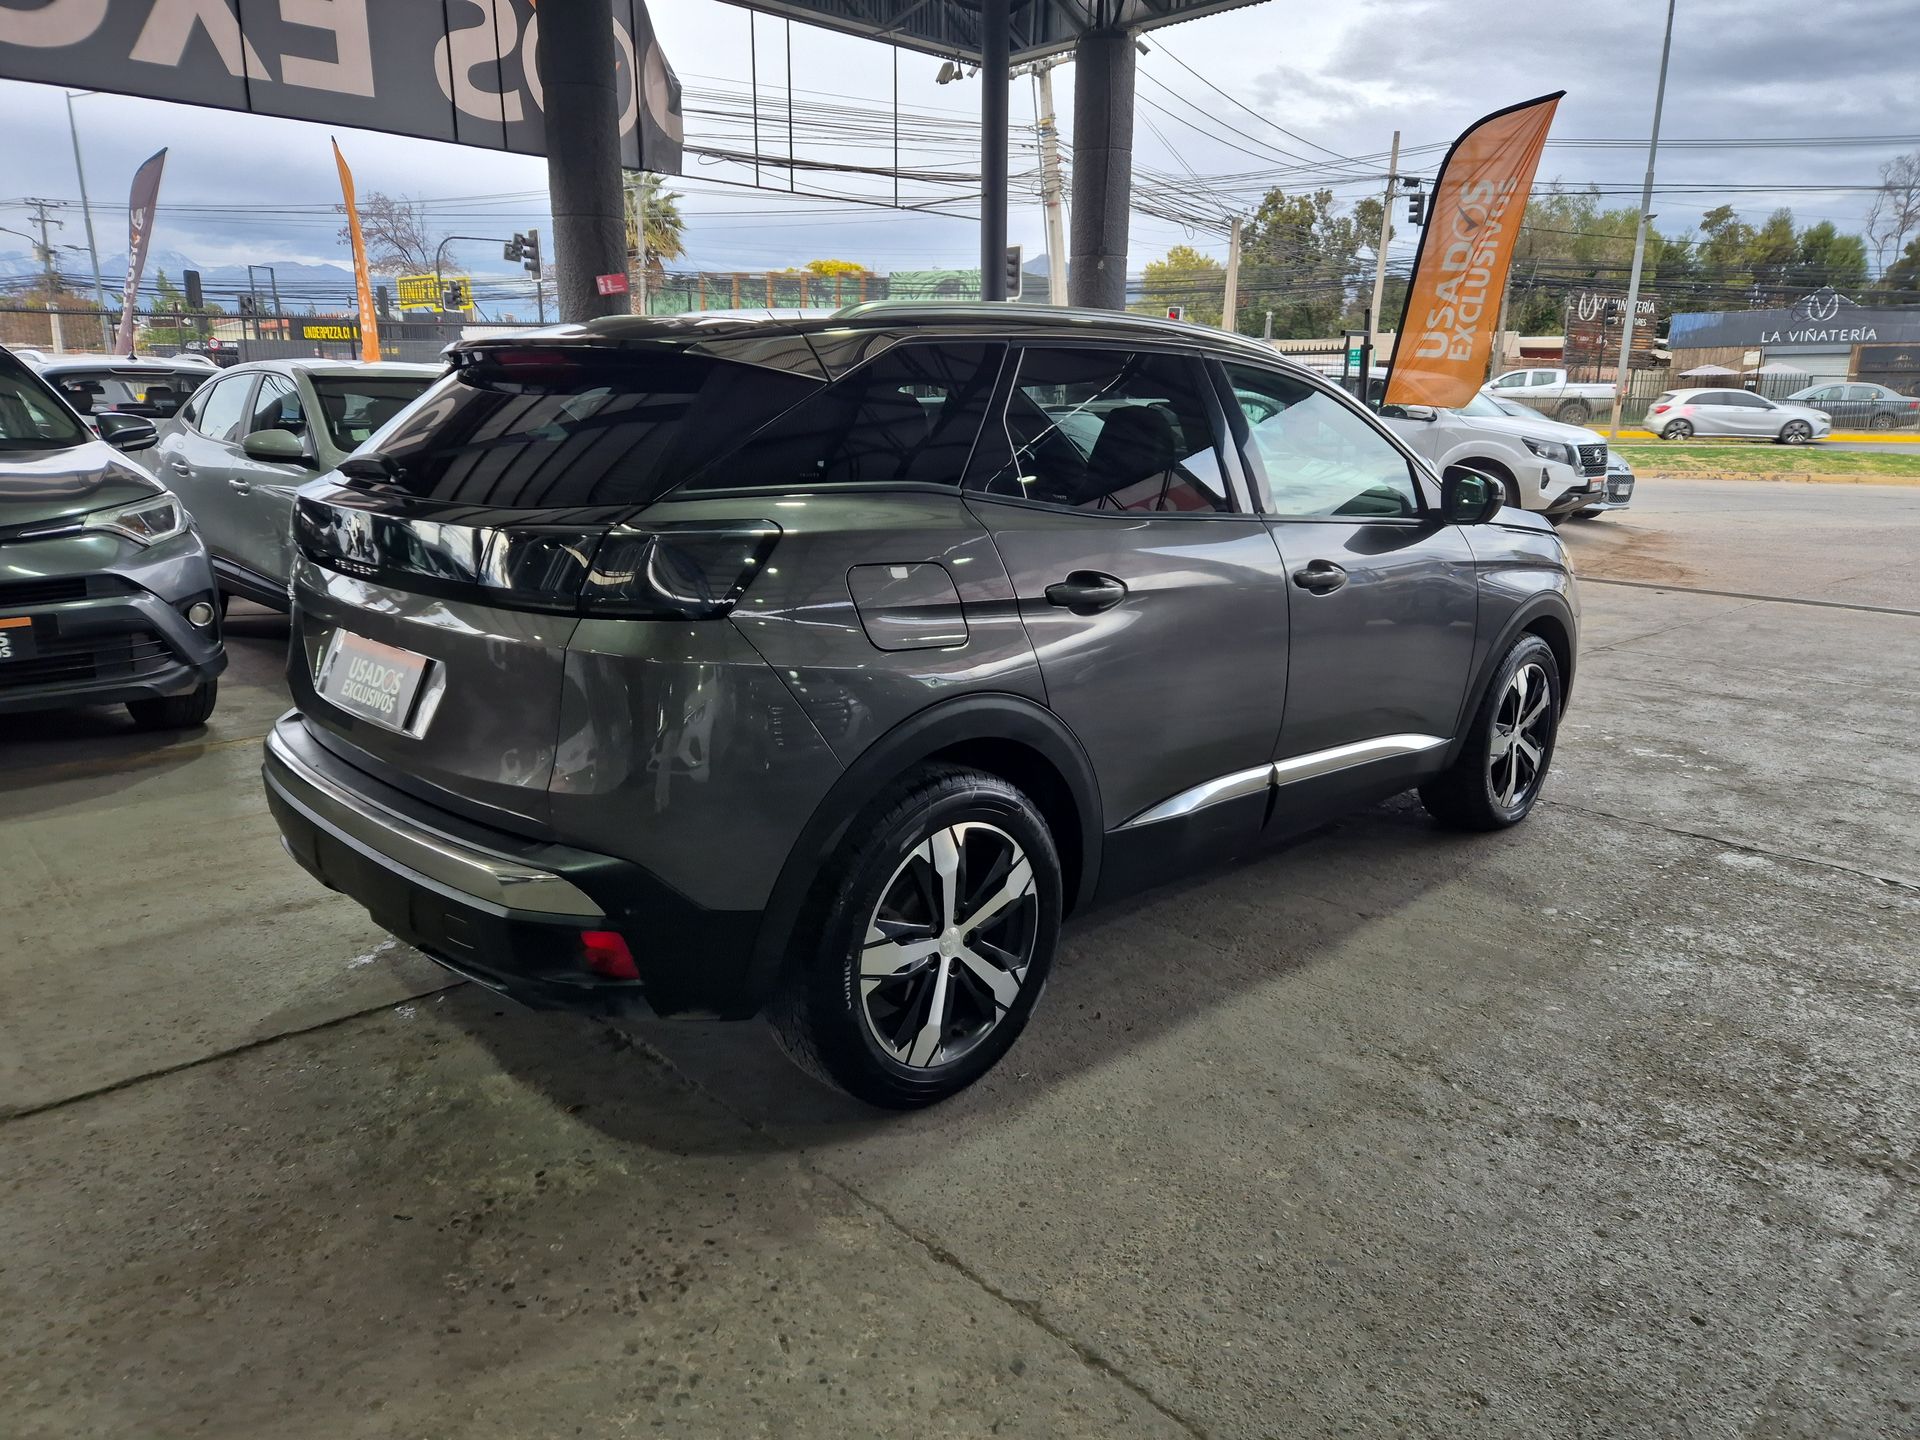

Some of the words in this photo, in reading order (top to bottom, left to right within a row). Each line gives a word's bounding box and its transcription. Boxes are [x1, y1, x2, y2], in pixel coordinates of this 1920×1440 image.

[1415, 179, 1495, 358] USADOS
[1447, 176, 1518, 361] EXCLUSIVOS
[303, 326, 358, 339] UNDERPIZZA.C
[1761, 331, 1781, 343] LA
[1789, 326, 1877, 342] VIÑATERÍA
[349, 656, 404, 695] USADOS
[341, 679, 396, 714] EXCLUSIVOS
